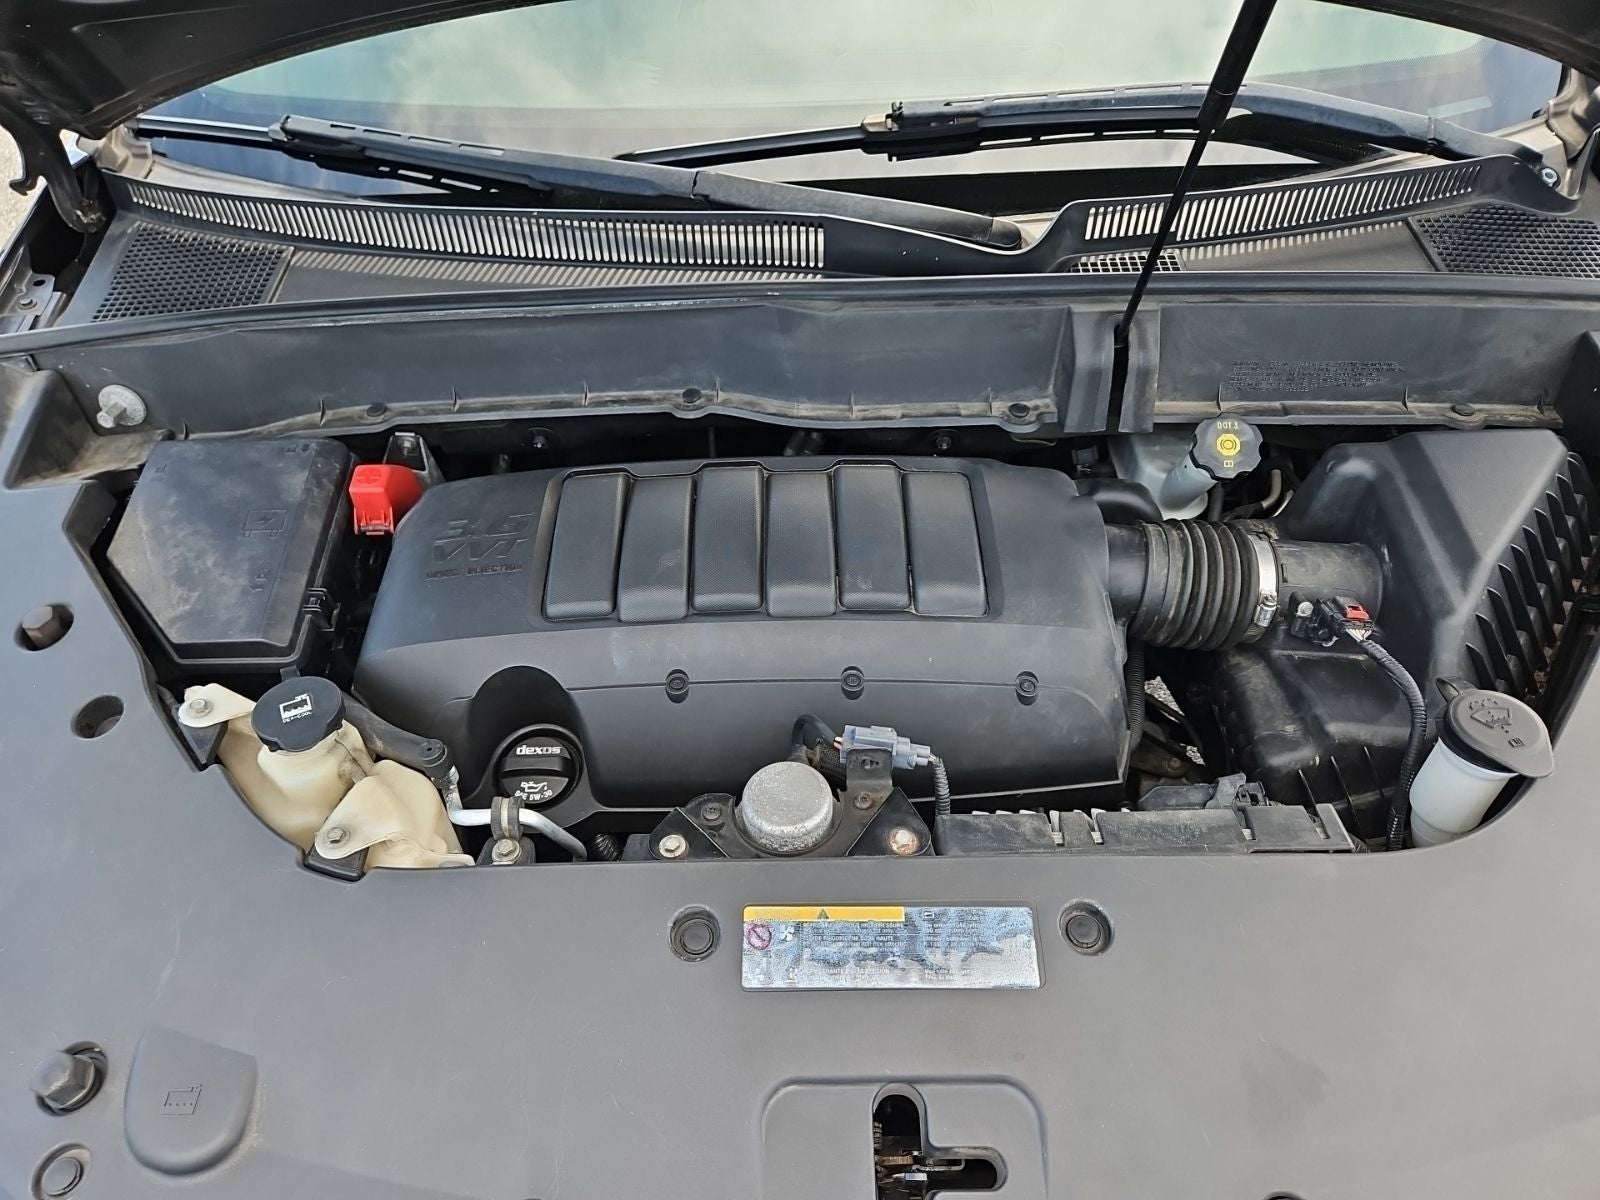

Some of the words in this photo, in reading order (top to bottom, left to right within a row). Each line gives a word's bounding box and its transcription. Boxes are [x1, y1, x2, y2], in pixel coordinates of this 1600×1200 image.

[1217, 421, 1232, 429] DOT
[1233, 421, 1239, 430] 3
[515, 744, 562, 755] dexos
[529, 789, 553, 801] 5W-30
